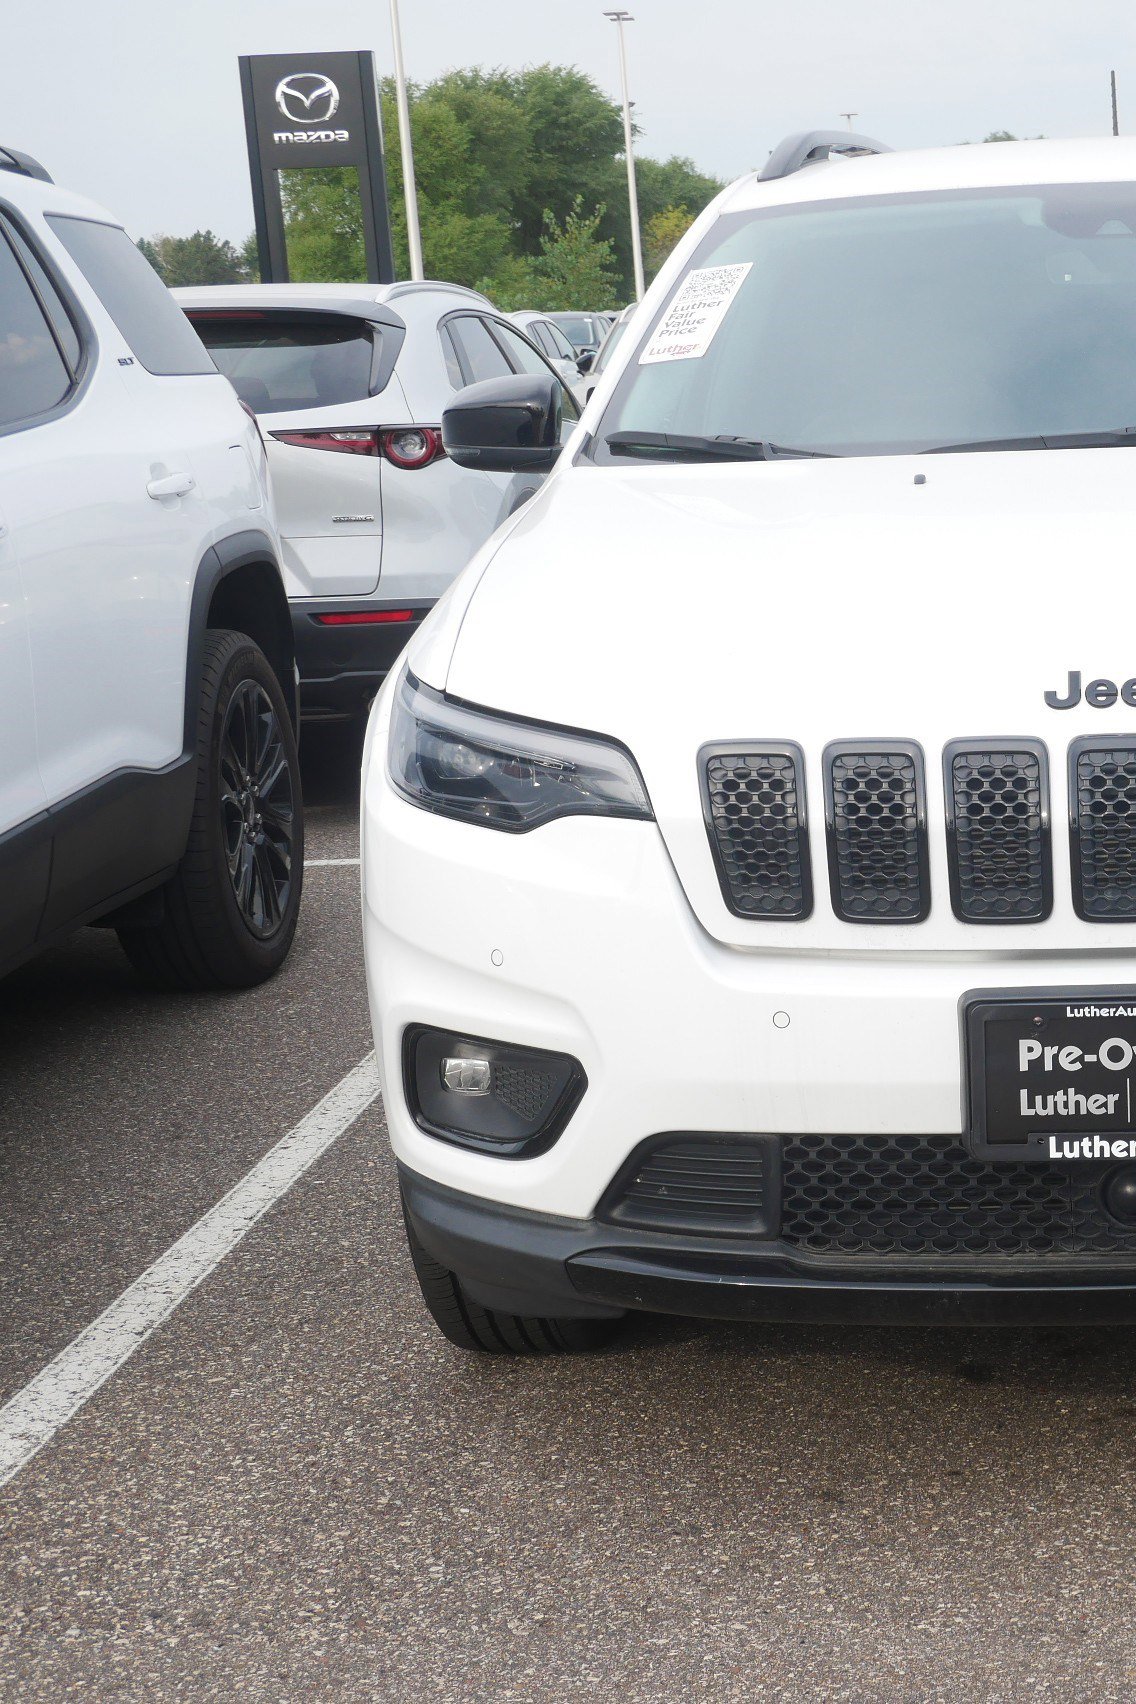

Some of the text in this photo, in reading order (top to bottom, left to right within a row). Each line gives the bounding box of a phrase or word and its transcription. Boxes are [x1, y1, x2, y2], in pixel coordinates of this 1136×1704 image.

[672, 301, 724, 312] Luther
[667, 312, 696, 321] Fair
[664, 318, 706, 328] Value
[658, 327, 698, 337] Price
[648, 344, 700, 356] Luther
[1019, 1088, 1120, 1116] Luther
